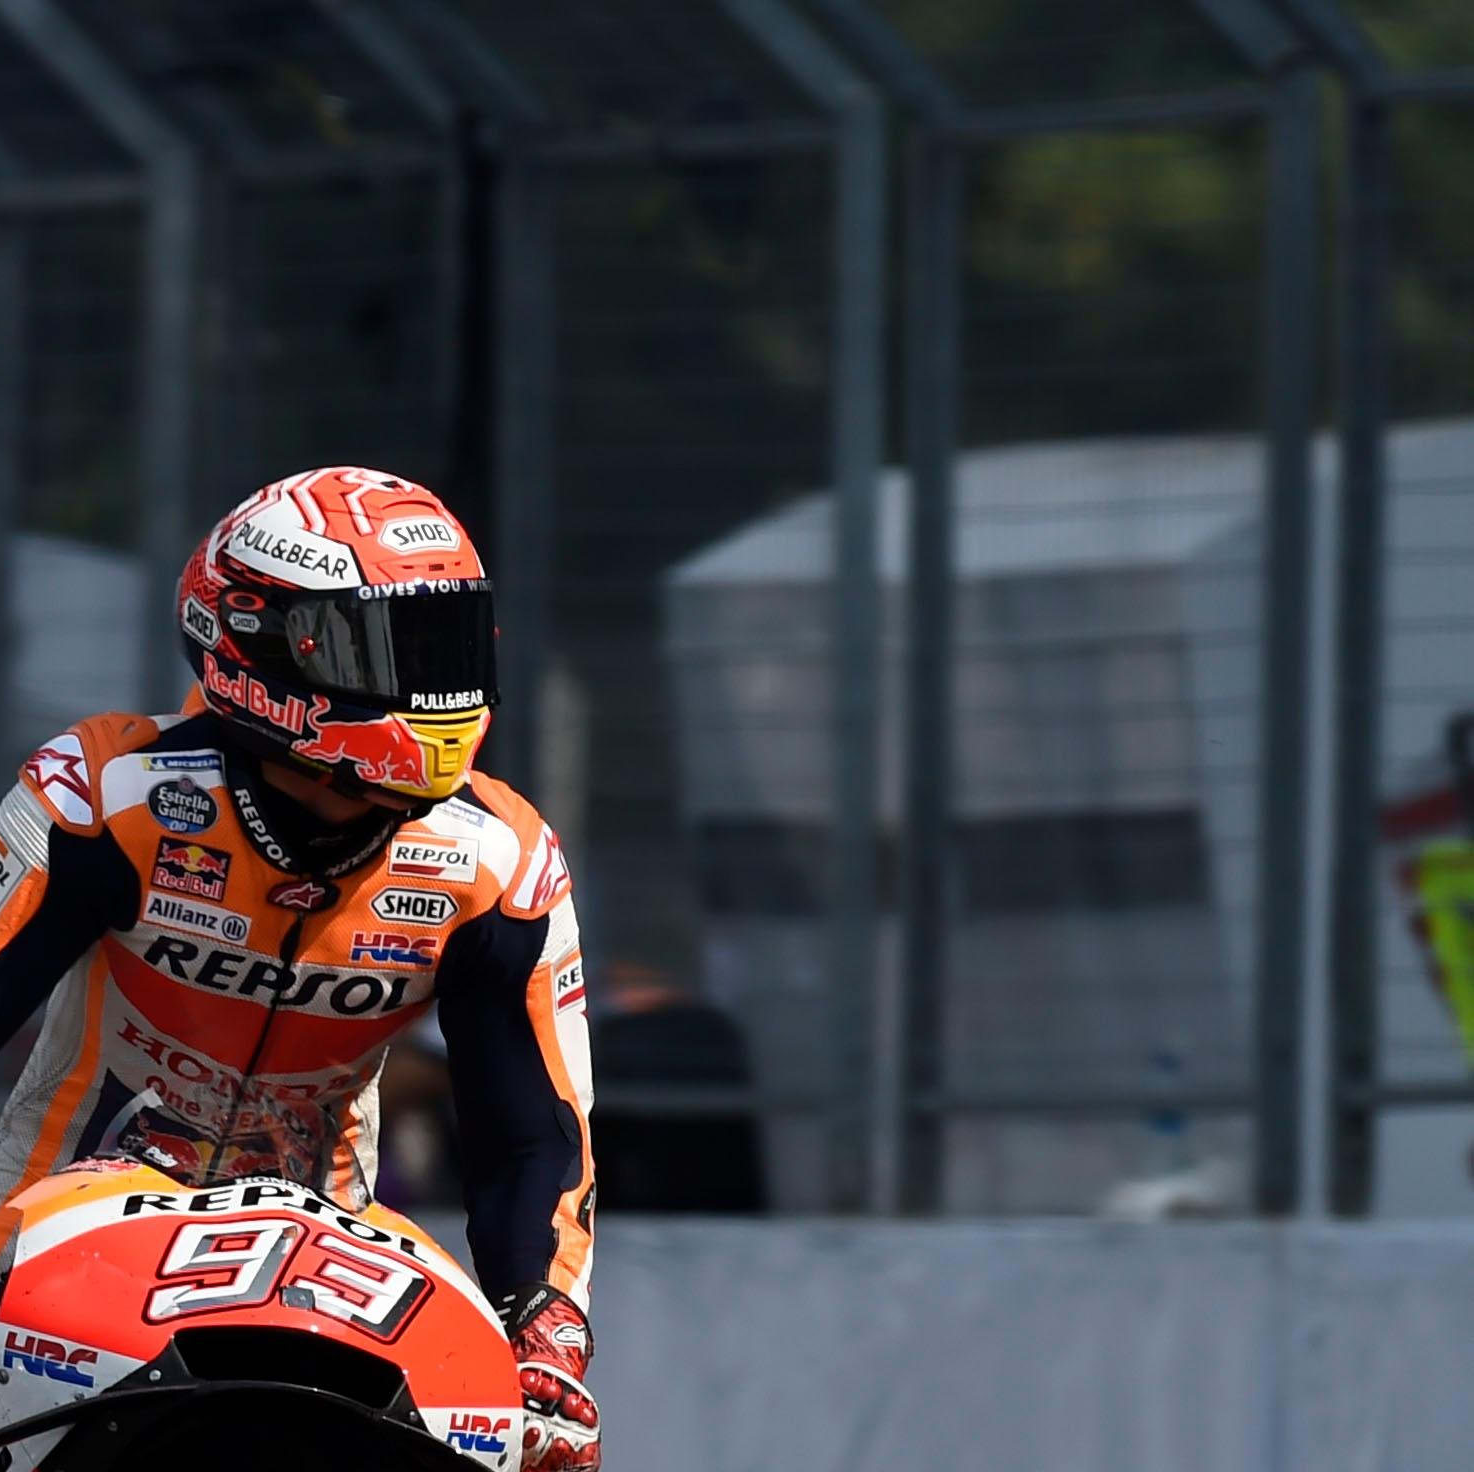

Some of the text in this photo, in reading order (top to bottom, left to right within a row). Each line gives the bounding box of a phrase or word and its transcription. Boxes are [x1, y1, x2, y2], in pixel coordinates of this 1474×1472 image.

[236, 523, 349, 580] PULL&BEAR
[392, 523, 452, 546] SHOEI
[358, 582, 416, 600] GIVES
[425, 578, 461, 594] YOU
[186, 602, 214, 640] SHOEI
[203, 650, 247, 708] Red
[248, 677, 306, 735] Bull
[411, 689, 484, 710] PULL&BEAR
[157, 786, 210, 811] Estrella
[157, 802, 205, 825] Galicia
[235, 788, 292, 870] REPSOL
[395, 846, 470, 867] REPSOL
[154, 867, 224, 902] Red Bull
[148, 898, 219, 931] Allianz
[383, 895, 446, 919] SHOEI
[350, 932, 439, 965] HRC
[143, 935, 411, 1016] REPSOL
[144, 1075, 202, 1117] One
[122, 1185, 431, 1264] REPSOL
[142, 1217, 435, 1346] 93
[3, 1330, 98, 1389] HRC
[447, 1413, 512, 1454] HRC
